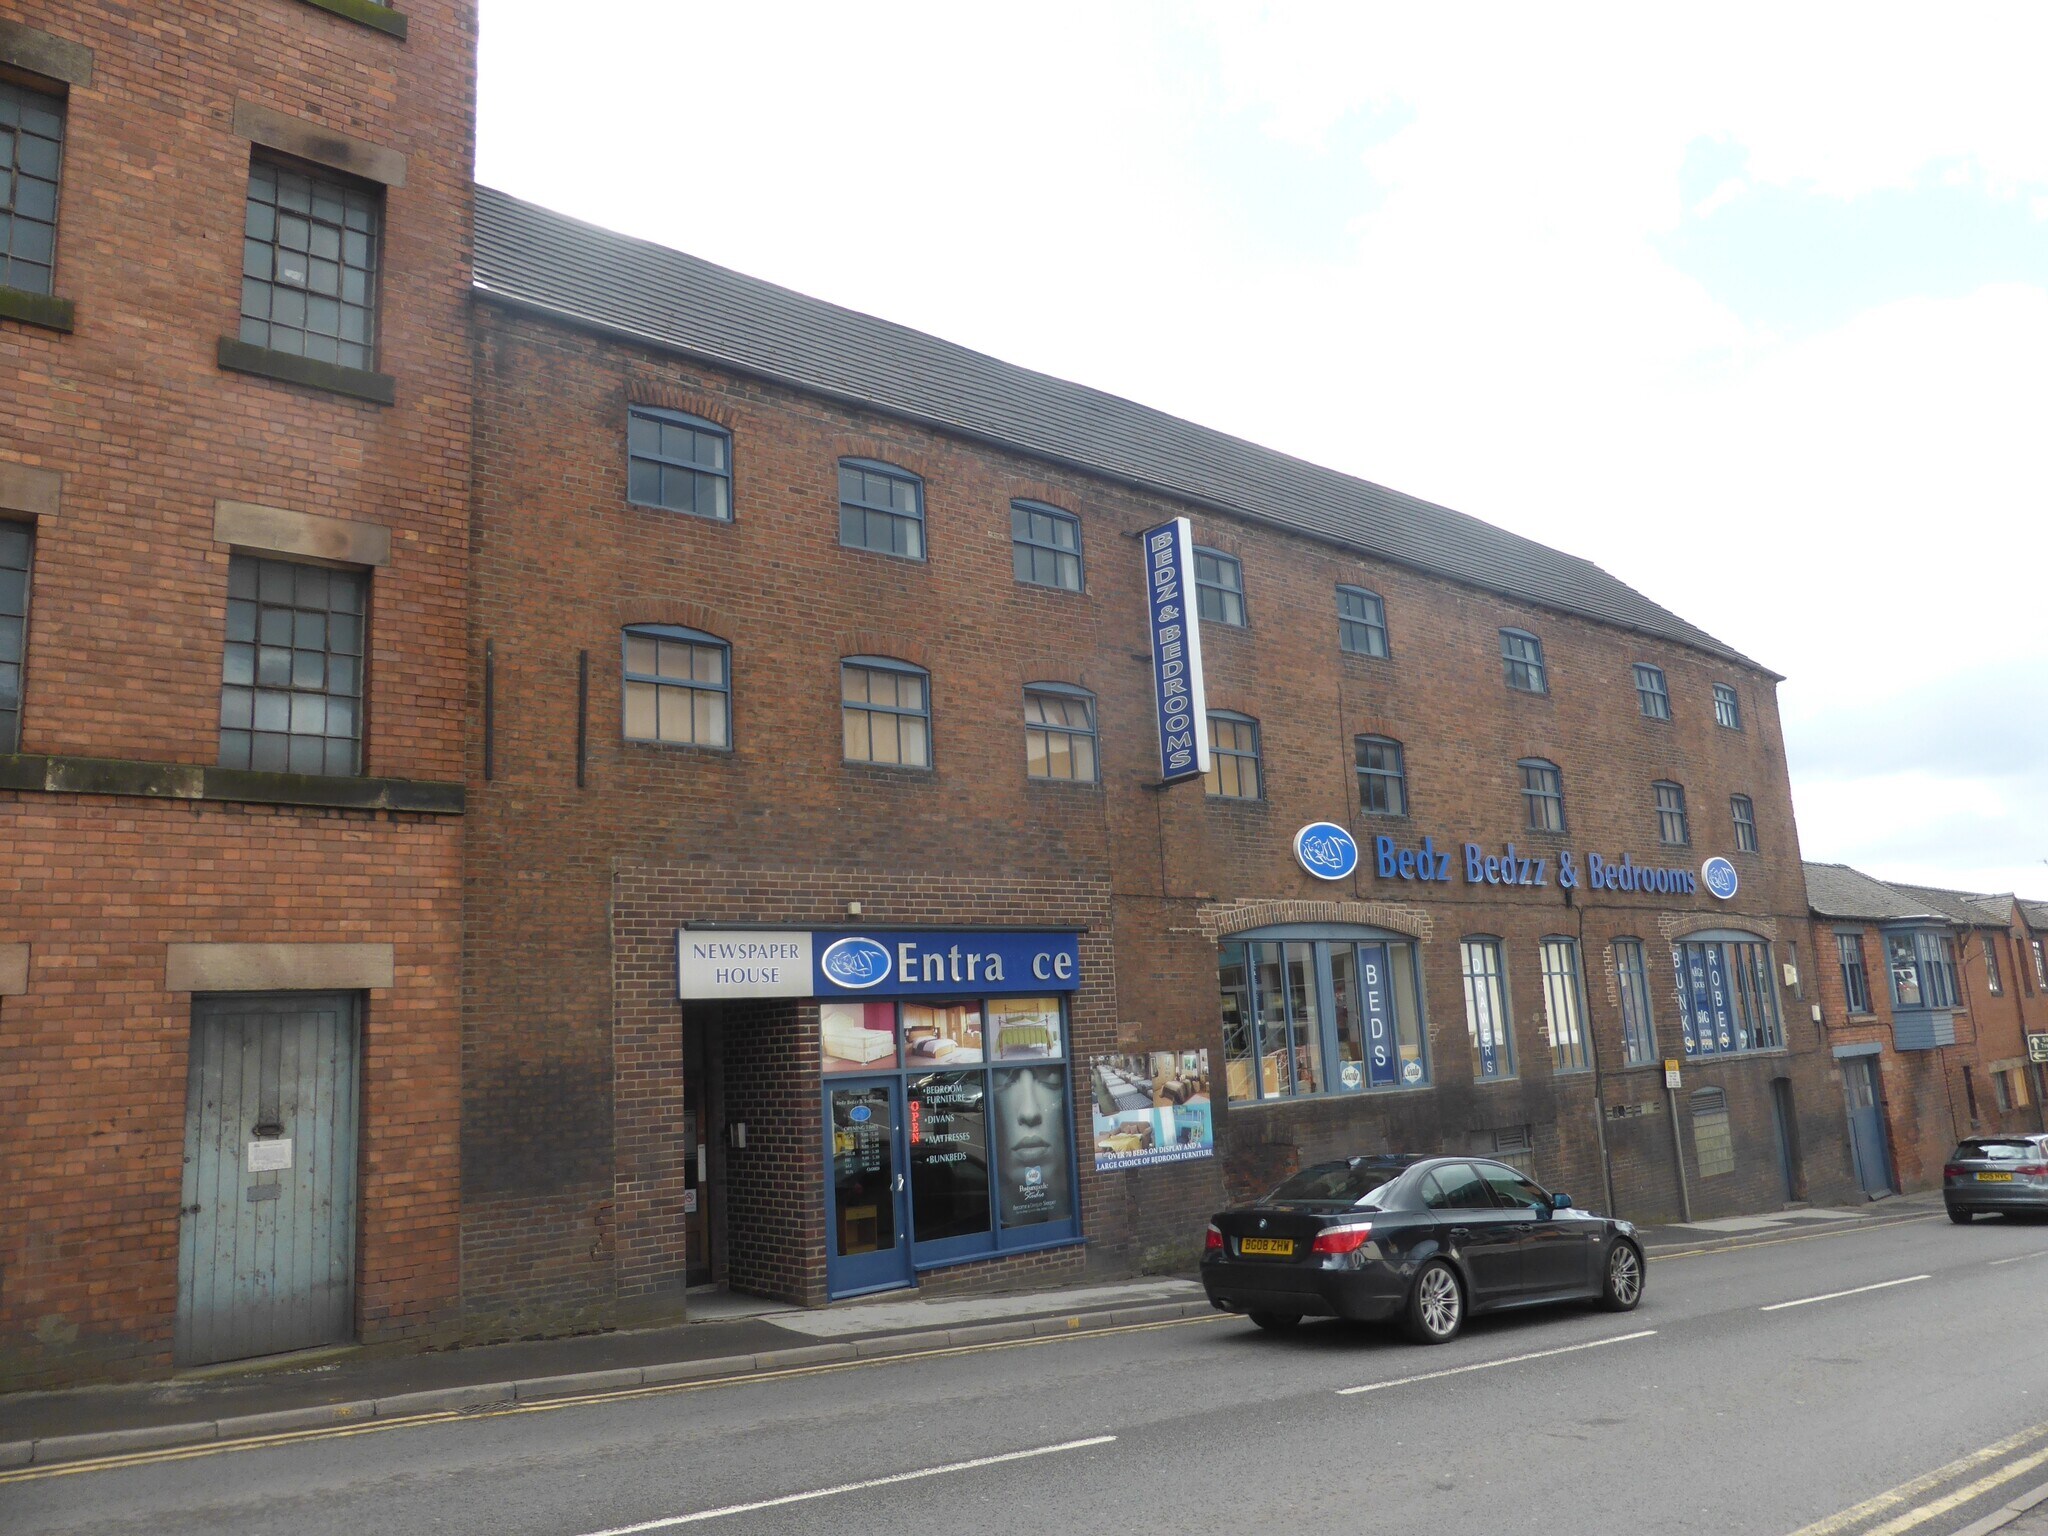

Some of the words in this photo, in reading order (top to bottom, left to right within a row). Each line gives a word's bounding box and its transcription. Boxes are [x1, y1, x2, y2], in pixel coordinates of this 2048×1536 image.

[1151, 531, 1178, 603] BEDZ
[1158, 605, 1179, 623] &
[1159, 624, 1192, 769] BEDROOMS
[1376, 835, 1452, 881] Bedz
[1464, 842, 1548, 887] Bedzz
[1559, 850, 1580, 888] &
[1589, 852, 1696, 896] Bedrooms
[693, 942, 800, 959] NEWSPAPER
[716, 967, 780, 984] HOUSE
[1673, 952, 1693, 1053] BUNKS
[1708, 950, 1730, 1048] ROBES
[1366, 964, 1386, 1067] BEDS
[1472, 958, 1493, 1073] DRAWERS
[1343, 1069, 1359, 1082] Sealy
[1405, 1065, 1420, 1078] Sealy
[926, 1085, 962, 1094] BEDROOM
[926, 1094, 966, 1104] FURNITURE
[911, 1101, 920, 1143] OPEN
[927, 1114, 955, 1124] DIVANS
[929, 1132, 970, 1144] MATTRESSES
[929, 1152, 967, 1164] BUNKBEDS
[1096, 1161, 1118, 1170] LARGE
[1118, 1157, 1141, 1167] CHOICE
[1142, 1156, 1151, 1164] OF
[1151, 1152, 1180, 1164] BEDROOM
[1181, 1149, 1212, 1159] FURNITURE
[1108, 1151, 1125, 1160] OVER
[1132, 1148, 1148, 1156] BEDS
[1149, 1147, 1158, 1155] ON
[1159, 1143, 1182, 1153] DISPLAY
[1183, 1142, 1196, 1150] AND
[1245, 1239, 1268, 1251] BG08
[1270, 1240, 1290, 1252] ZHW
